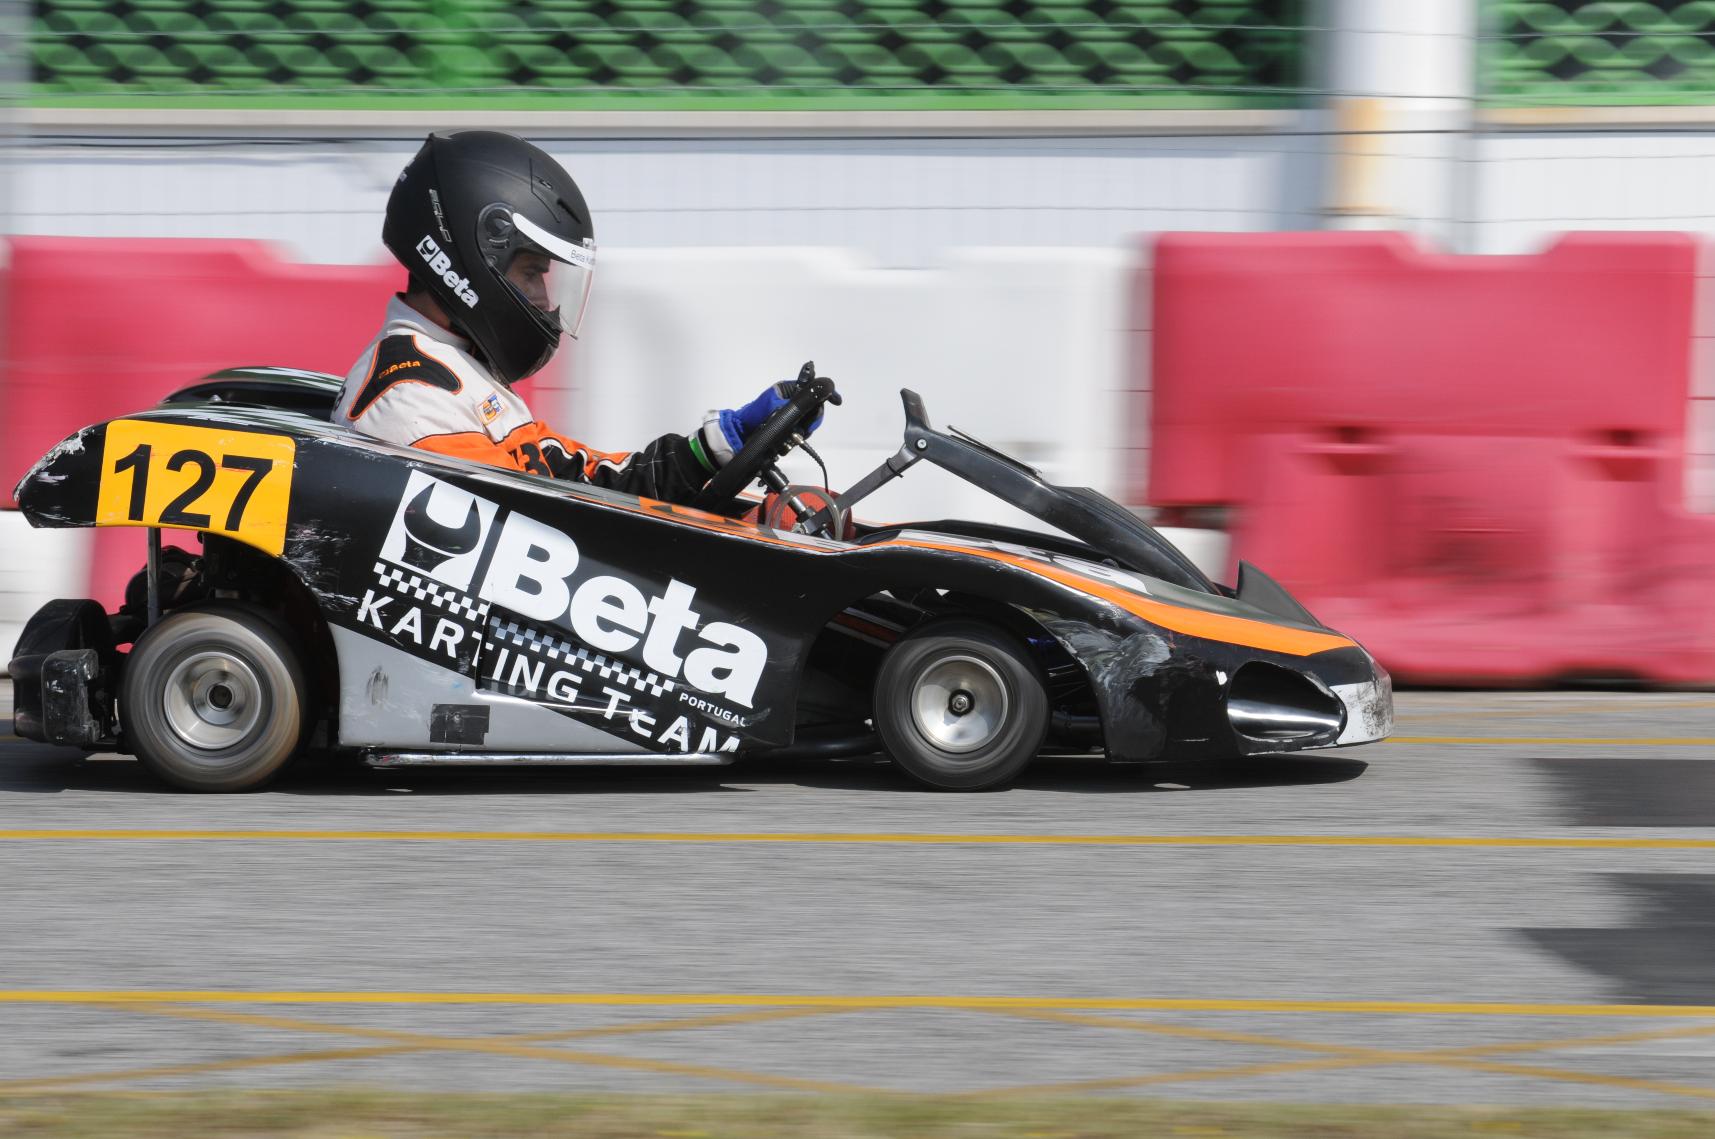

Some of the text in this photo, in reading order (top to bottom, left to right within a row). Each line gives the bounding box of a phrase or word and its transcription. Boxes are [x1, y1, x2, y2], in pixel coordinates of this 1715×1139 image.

[429, 250, 480, 308] Beta
[114, 444, 272, 532] 127
[478, 510, 768, 709] Beta
[356, 589, 741, 754] KARTING TEAM
[679, 692, 747, 727] PORTUGAL
